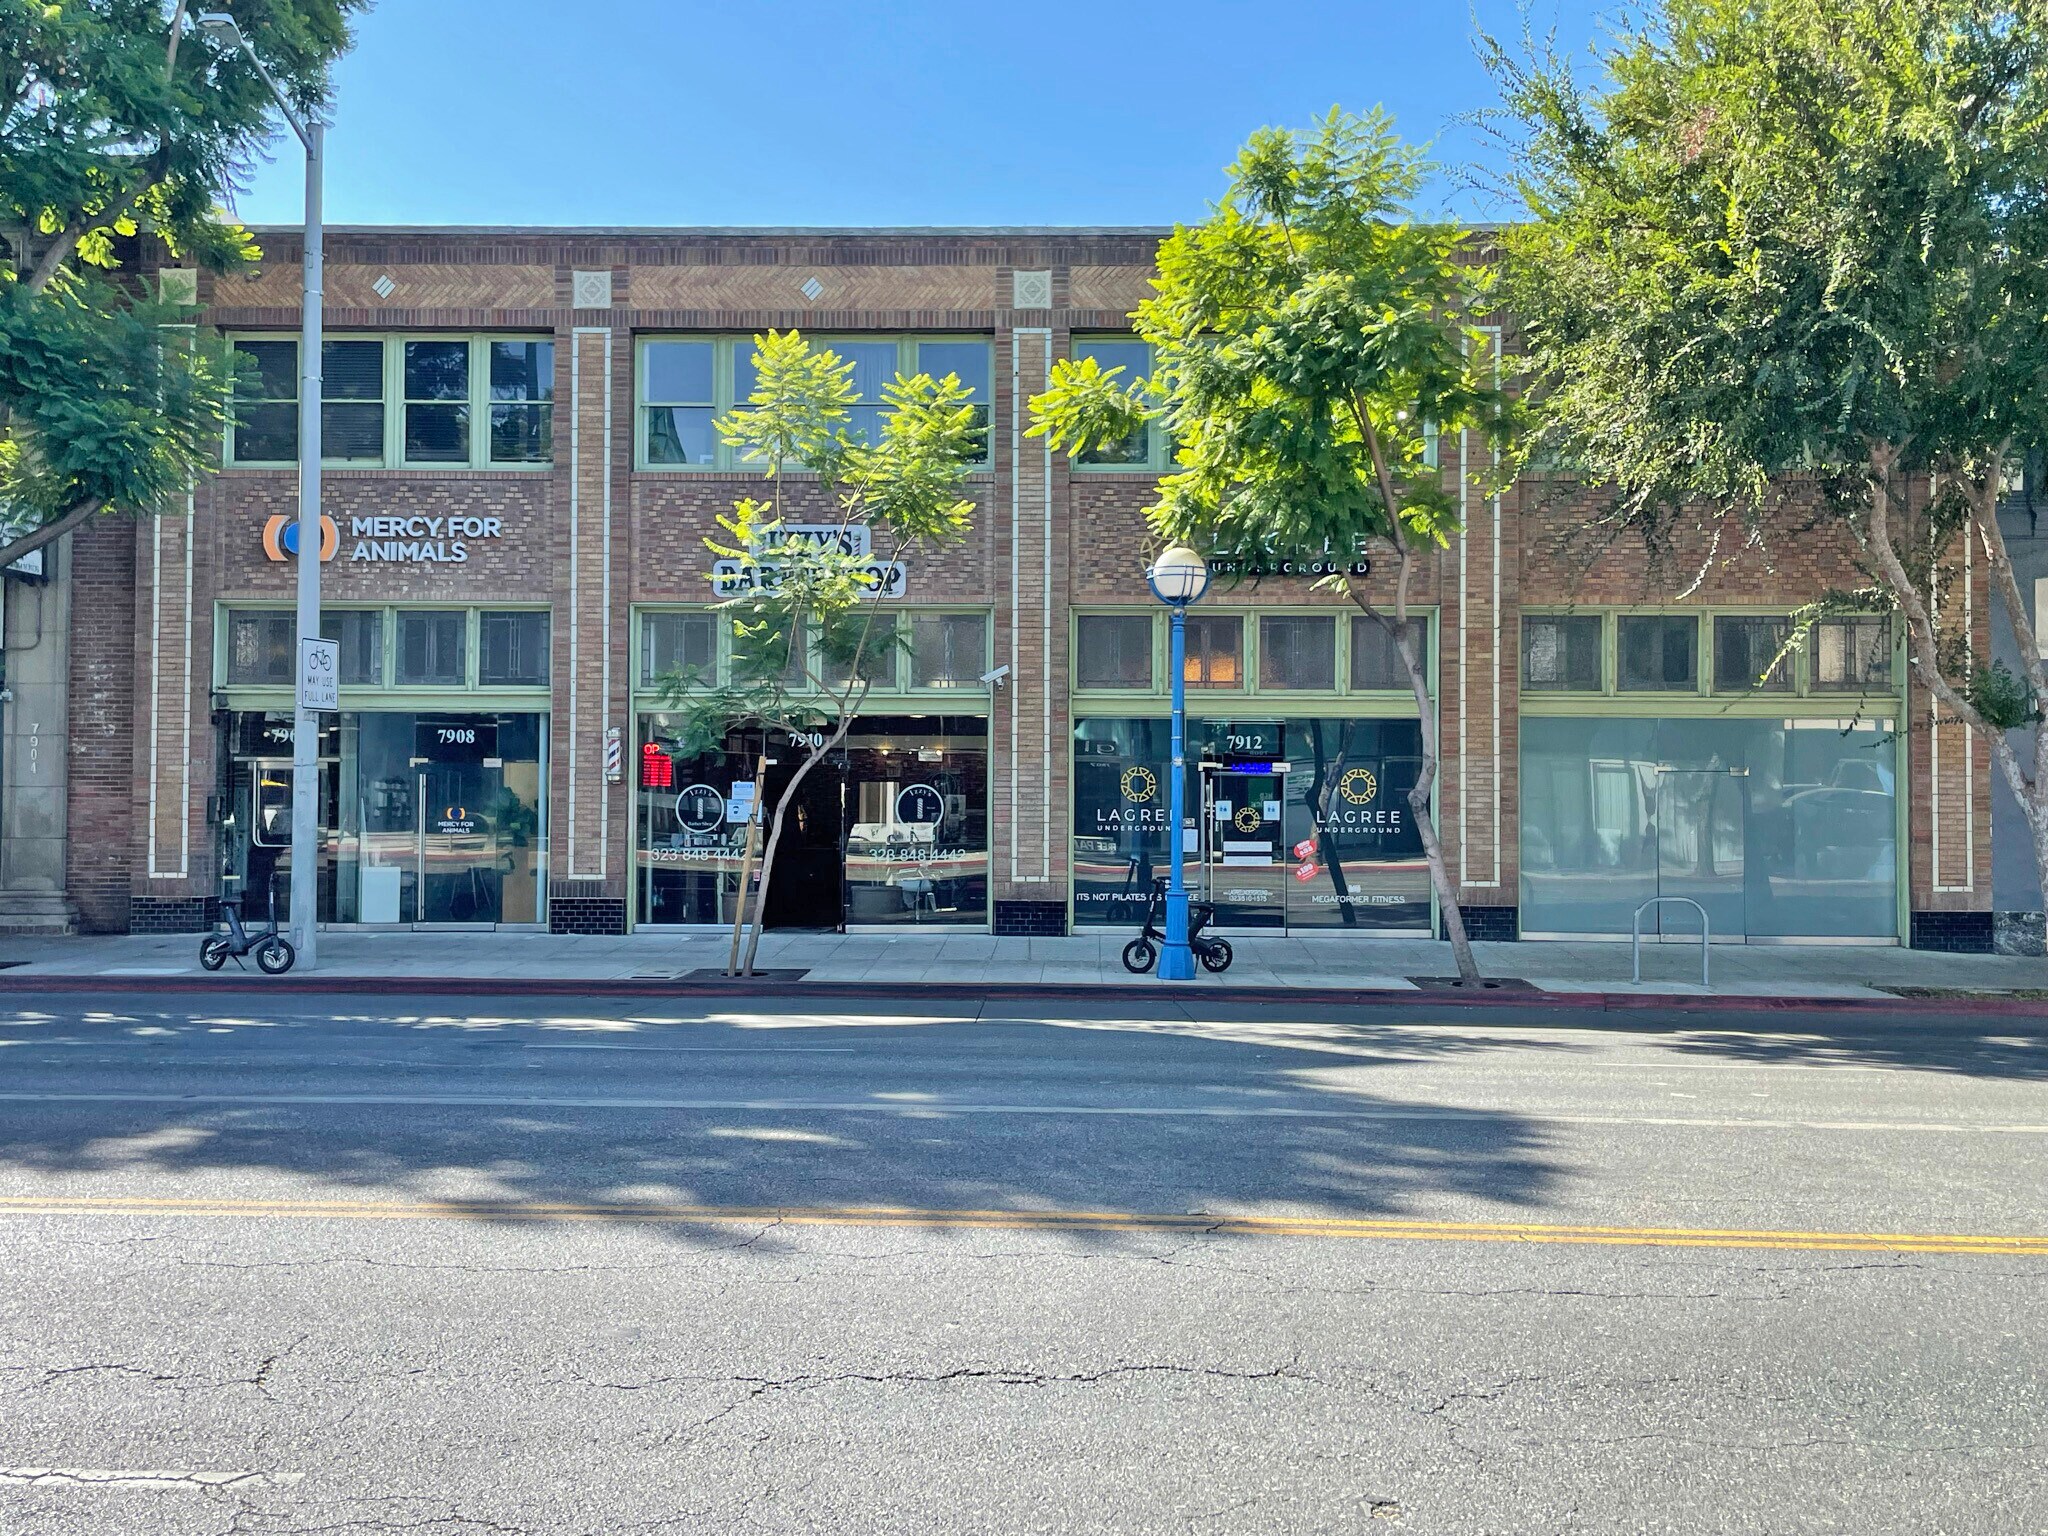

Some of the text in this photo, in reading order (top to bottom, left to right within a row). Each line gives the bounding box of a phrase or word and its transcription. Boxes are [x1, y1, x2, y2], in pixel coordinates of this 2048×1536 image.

[351, 516, 501, 538] MERCY FOR
[351, 541, 469, 562] ANIMALS
[307, 675, 333, 688] MAY USE
[304, 690, 336, 704] FULL LANE
[437, 729, 475, 743] 7908
[1226, 735, 1263, 749] 7912
[30, 722, 40, 775] 7904
[1316, 810, 1401, 824] LAGREE
[1096, 824, 1172, 832] UNDERGROUN
[651, 847, 678, 861] 323
[682, 847, 709, 861] 848
[900, 848, 926, 861] 848
[1092, 893, 1110, 901] NOT
[1111, 893, 1147, 901] PILATES
[1311, 895, 1406, 904] MEGAFORMER FITNESS
